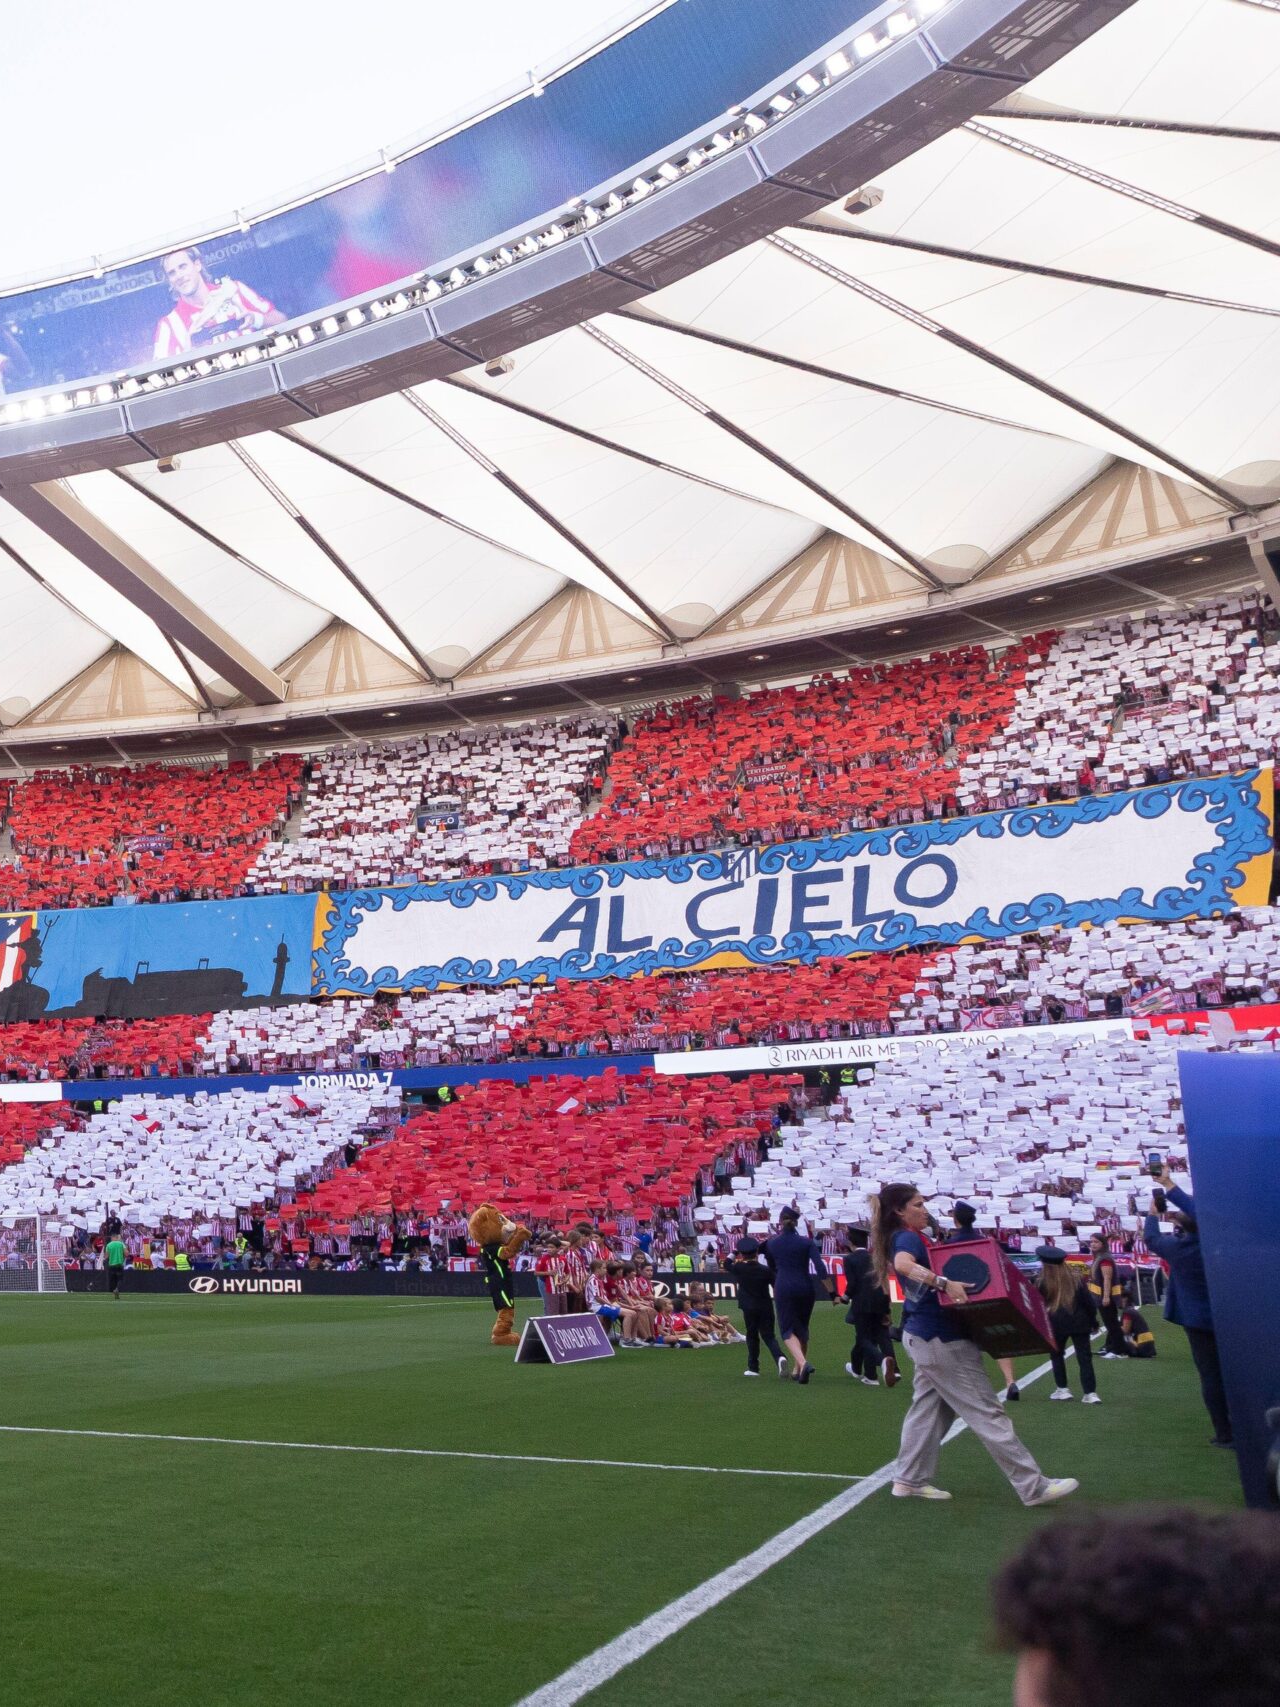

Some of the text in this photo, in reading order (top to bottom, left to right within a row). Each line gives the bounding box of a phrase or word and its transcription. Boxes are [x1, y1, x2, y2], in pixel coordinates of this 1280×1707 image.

[104, 275, 153, 296] MOTORS
[537, 853, 958, 954] AL CIELO
[786, 1046, 843, 1062] RIYADH
[847, 1043, 873, 1058] AIR
[298, 1071, 394, 1089] JORNADA 7
[223, 1279, 302, 1293] HYUNDAI
